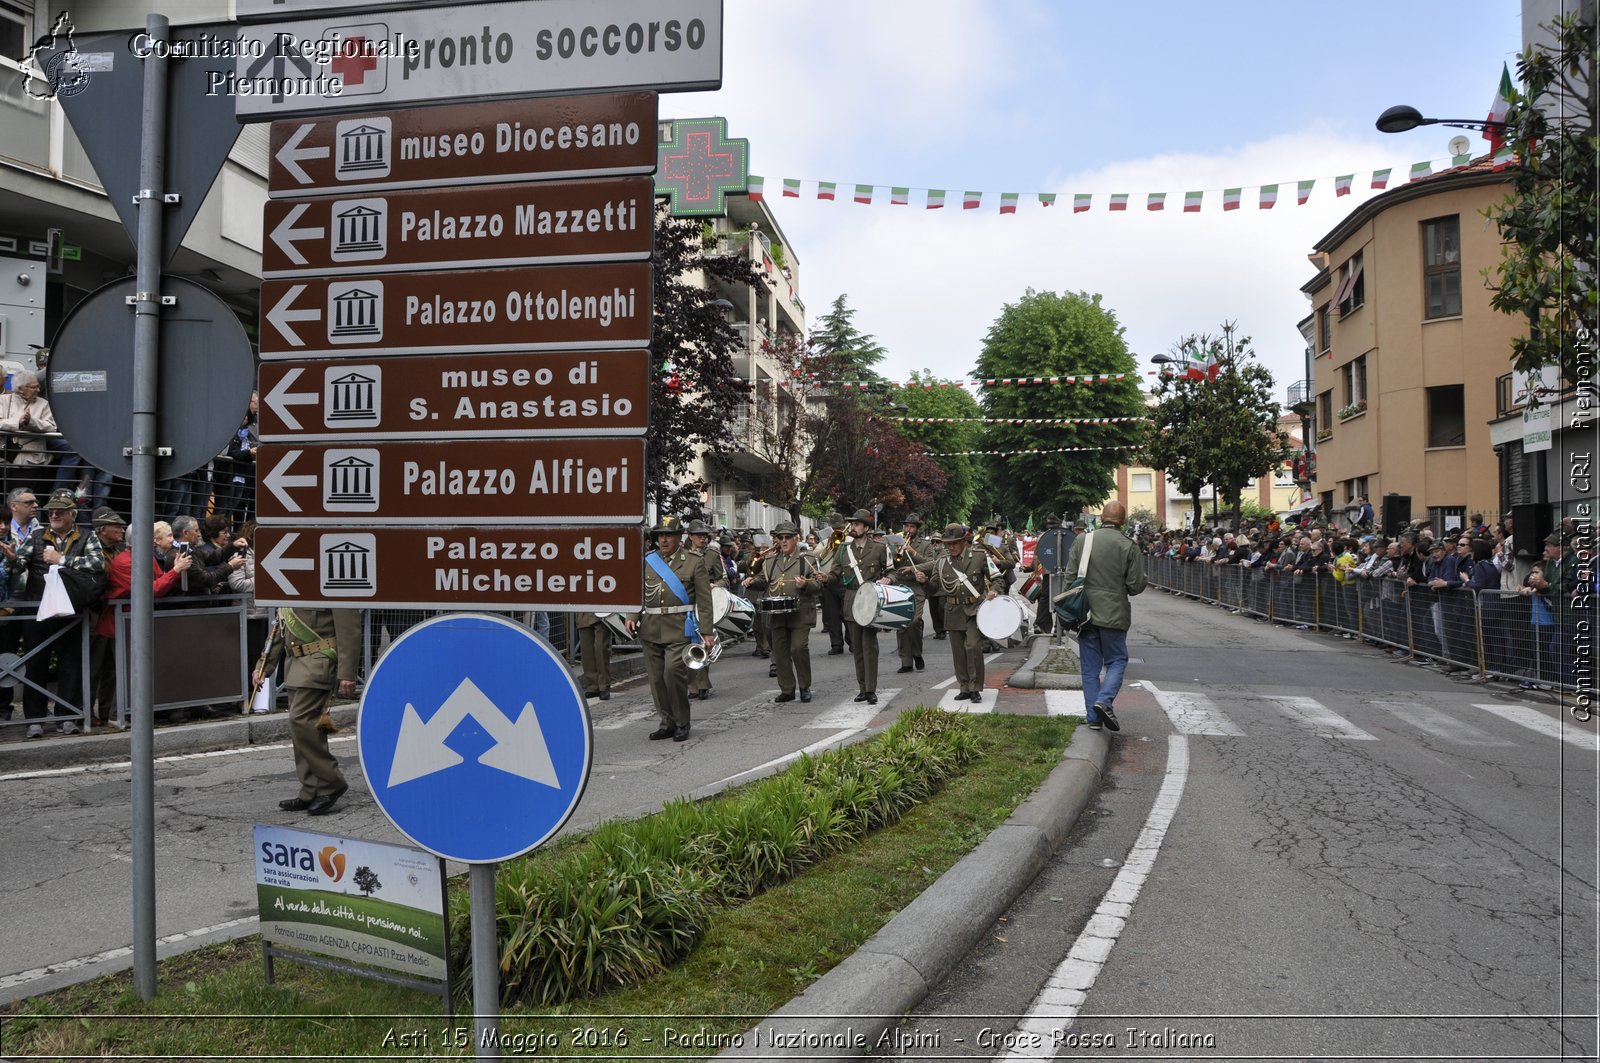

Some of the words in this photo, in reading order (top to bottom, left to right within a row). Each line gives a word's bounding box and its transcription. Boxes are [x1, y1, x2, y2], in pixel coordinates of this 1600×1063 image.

[402, 25, 514, 80] pronto
[535, 18, 706, 61] soccorso
[400, 131, 485, 160] museo
[496, 121, 640, 153] Diocesano
[401, 209, 504, 242] Palazzo
[515, 199, 636, 236] Mazzetti
[405, 294, 497, 326] Palazzo
[506, 287, 636, 327] Ottolenghi
[441, 367, 553, 388] museo
[568, 360, 598, 385] di
[408, 397, 440, 421] S.
[453, 393, 633, 420] Anastasio
[403, 460, 516, 496] Palazzo
[528, 457, 628, 494] Alfieri
[427, 536, 559, 561] Palazzo
[573, 536, 625, 561] del
[435, 568, 617, 593] Michelerio
[262, 842, 314, 872] sara
[263, 868, 276, 876] sara
[277, 870, 319, 884] assicurazioni
[279, 878, 290, 887] vita
[274, 896, 284, 911] Al
[286, 901, 310, 912] verde
[311, 900, 331, 916] della
[333, 905, 355, 920] città
[357, 912, 364, 922] ci
[367, 916, 406, 933] pensiamo
[274, 925, 295, 938] Patrizia
[319, 936, 350, 950] AGENZIA
[391, 950, 406, 962] P.zza
[408, 953, 429, 966] Medici
